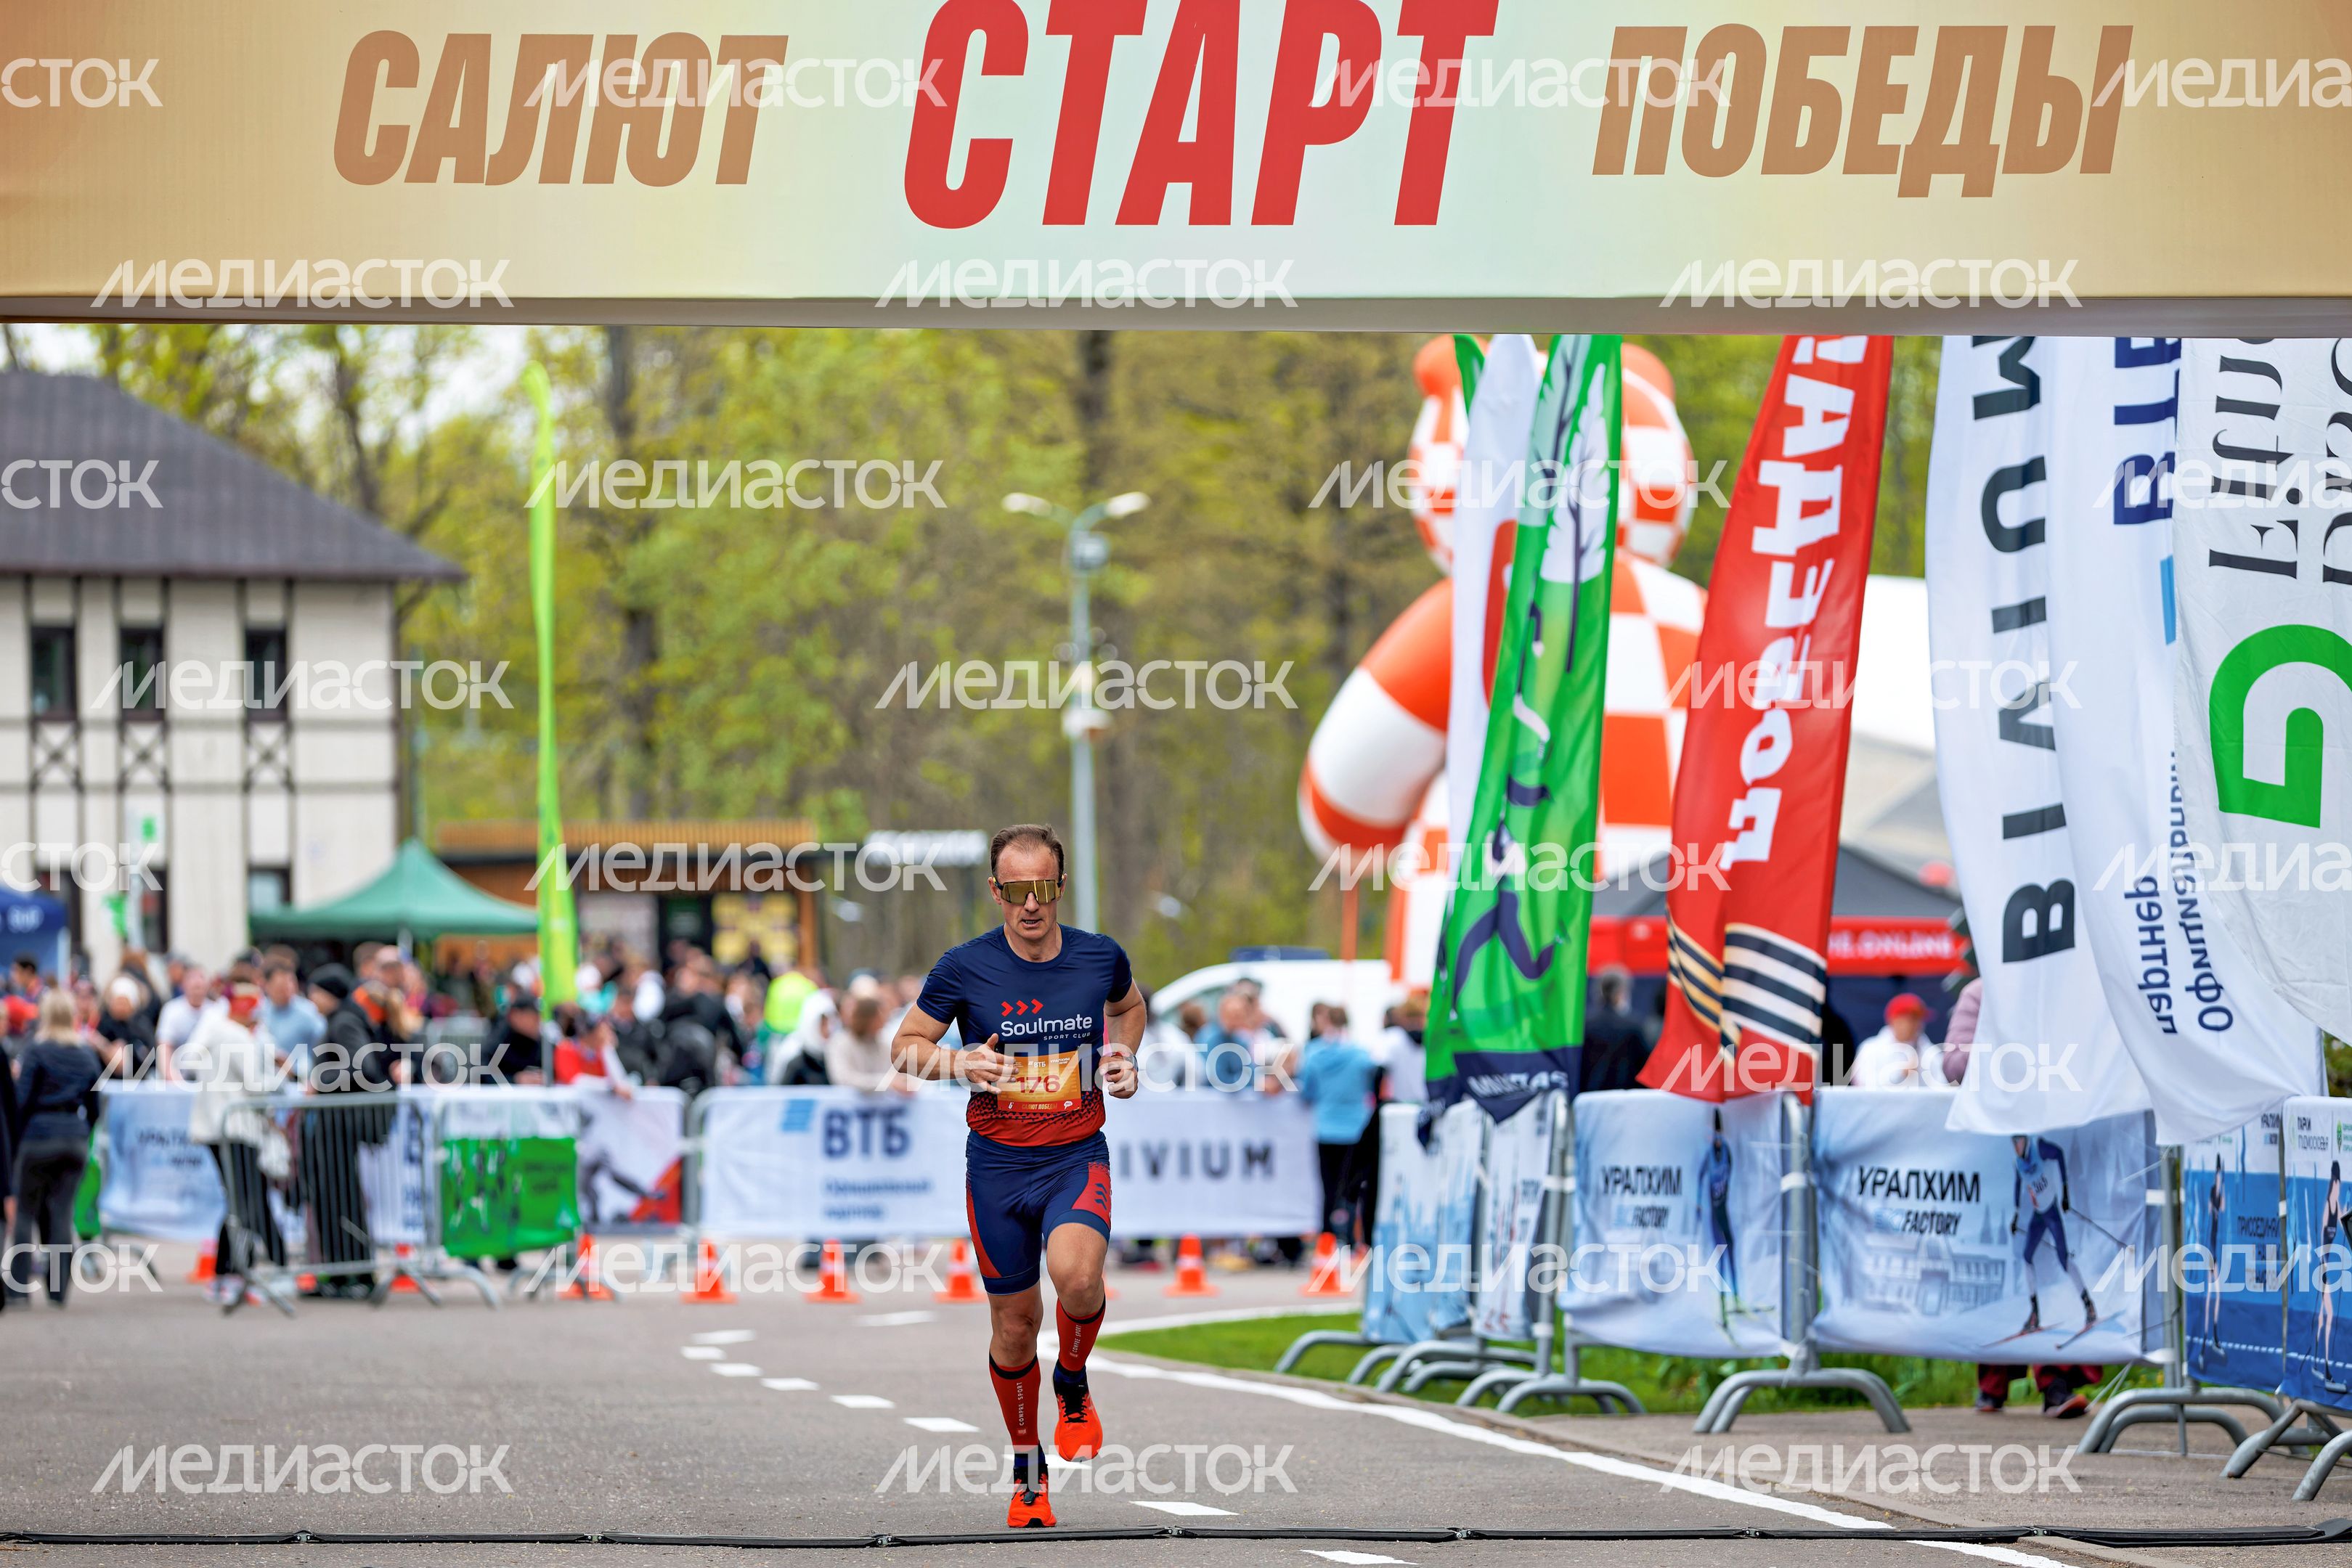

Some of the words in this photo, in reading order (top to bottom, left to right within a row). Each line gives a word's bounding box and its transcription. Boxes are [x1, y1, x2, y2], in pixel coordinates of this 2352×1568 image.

[333, 30, 789, 187] САЛЮТ
[904, 0, 1498, 229] СТАРТ
[1592, 23, 2133, 197] ПОБЕДЫ
[1001, 1013, 1093, 1037] Soulmate
[1017, 1074, 1060, 1093] 176
[823, 1107, 912, 1158] ВТБ
[1118, 1139, 1274, 1180] IVIUM
[1601, 1165, 1682, 1196] УРАЛХИМ
[1858, 1165, 1980, 1202] УРАЛХИМ
[1902, 1209, 1961, 1236] FACTORY
